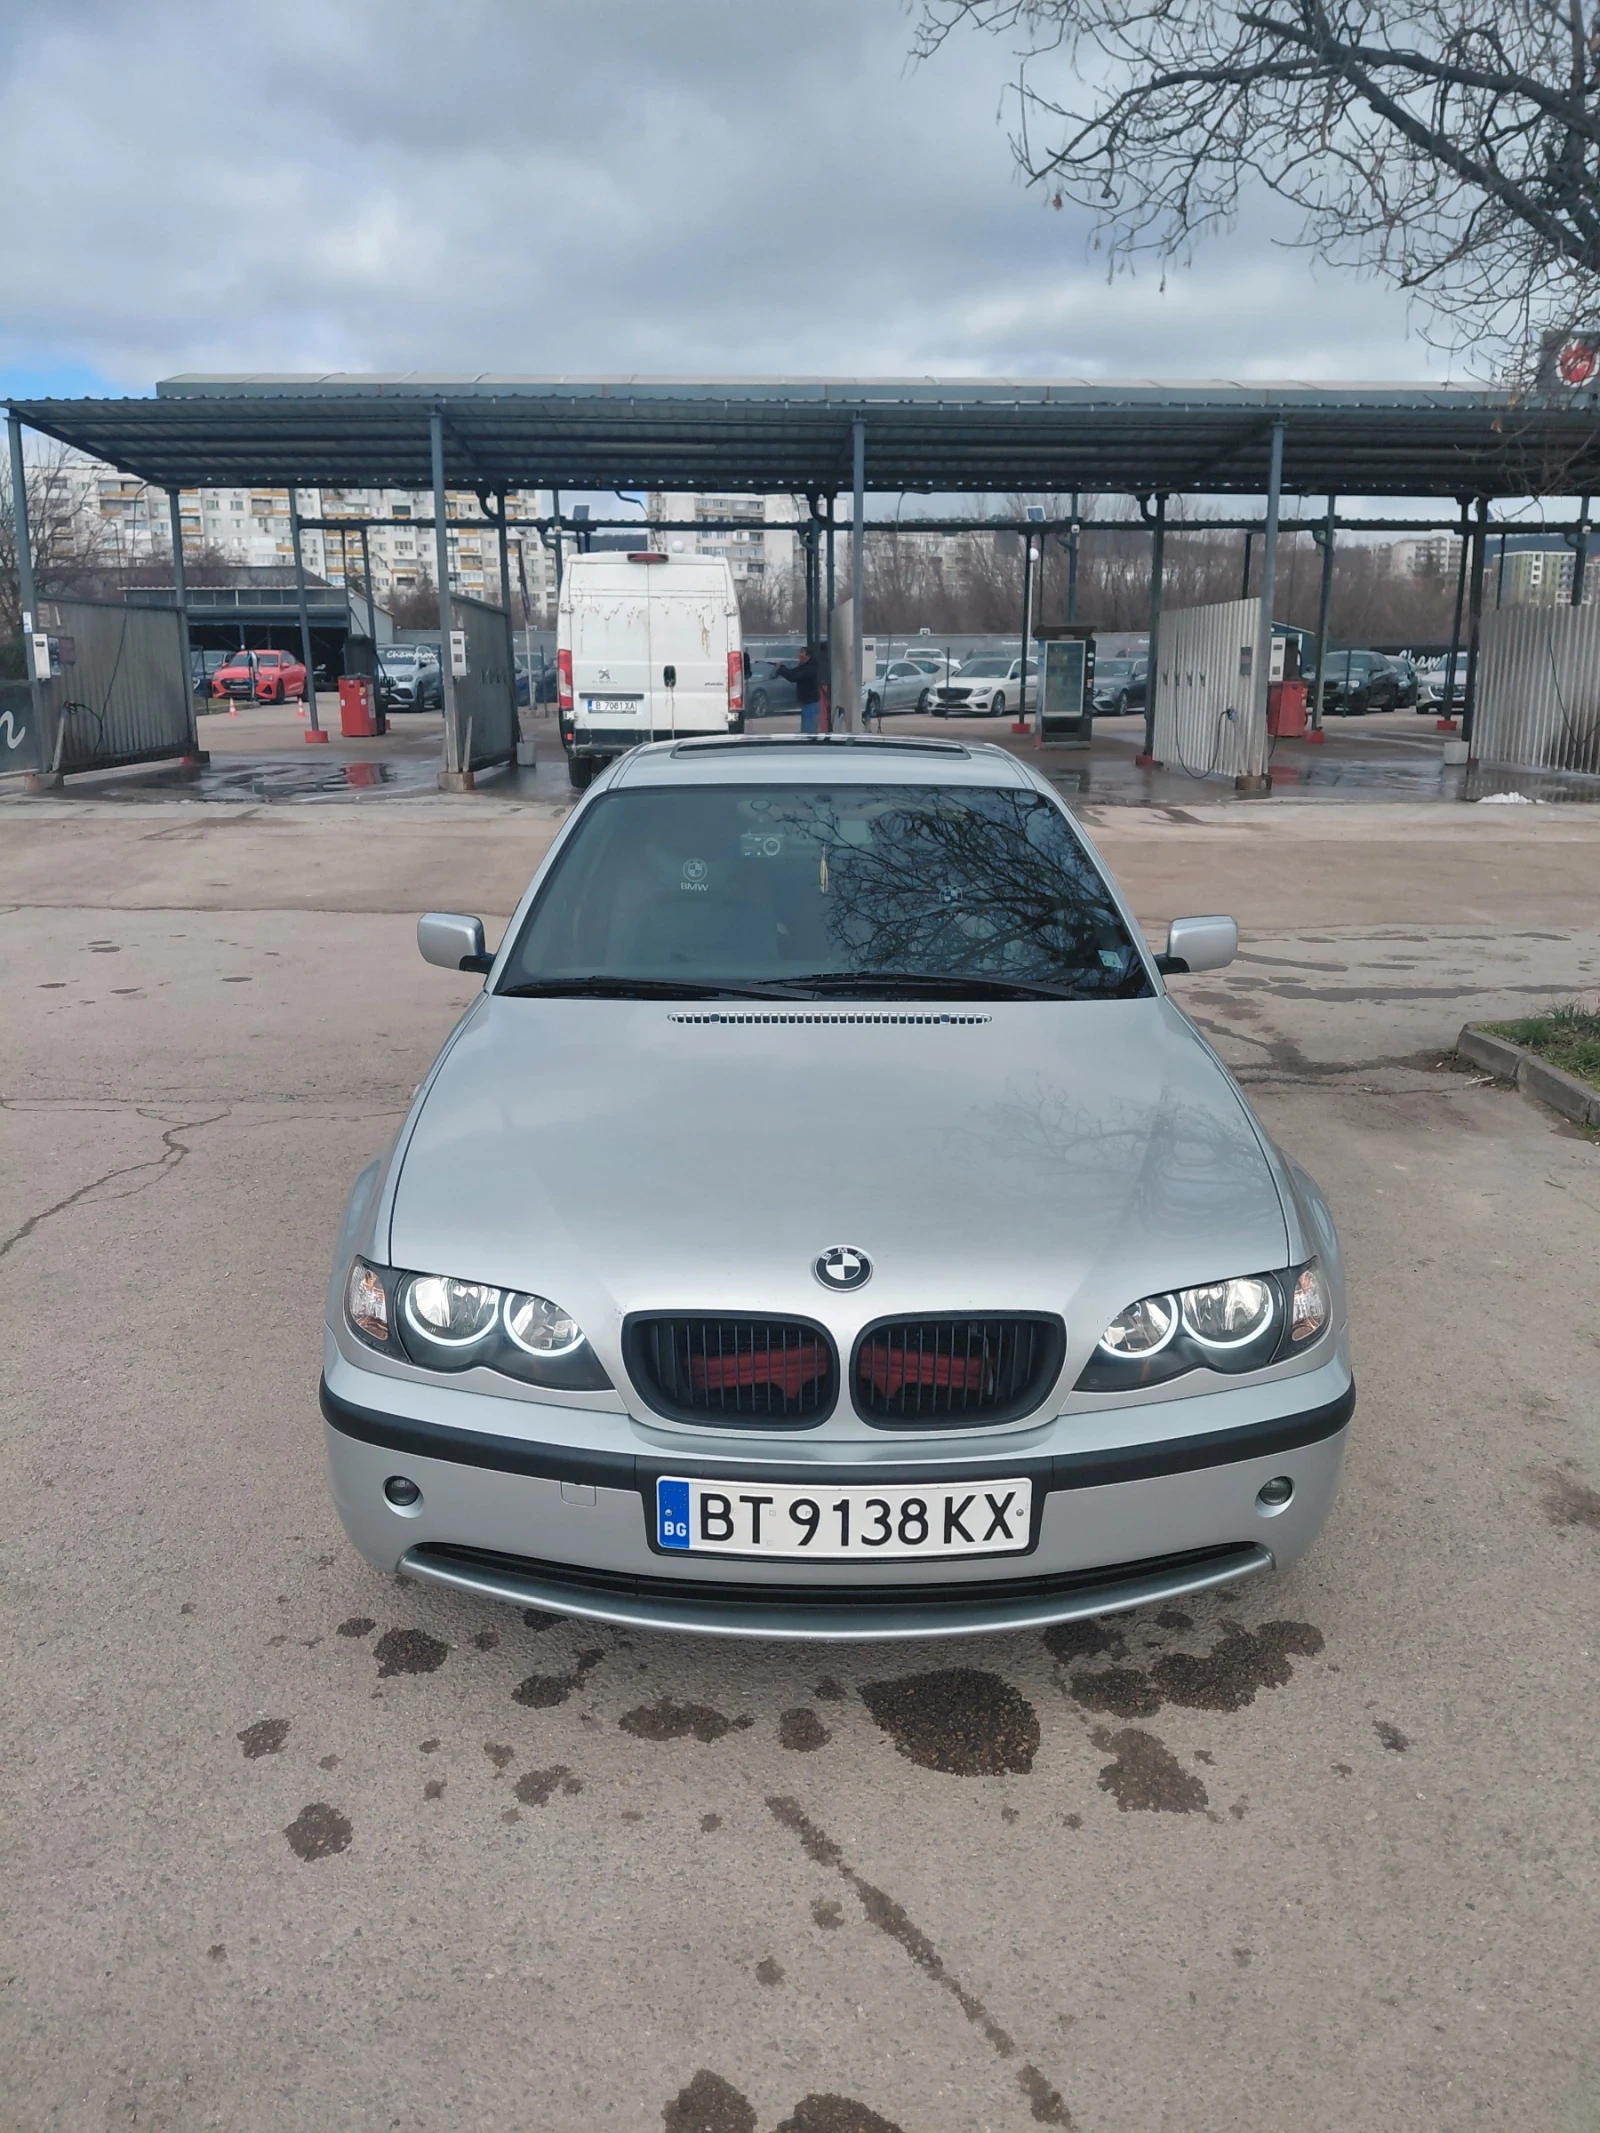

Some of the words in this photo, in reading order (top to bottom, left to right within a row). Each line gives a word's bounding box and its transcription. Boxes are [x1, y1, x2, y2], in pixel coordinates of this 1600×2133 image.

[595, 701, 601, 710] B
[625, 702, 635, 710] XA
[680, 882, 709, 891] BMW
[820, 1247, 866, 1260] BMW
[699, 1492, 774, 1545] BT
[788, 1497, 929, 1547] 9138
[943, 1491, 1016, 1545] KX
[664, 1522, 687, 1537] BG
